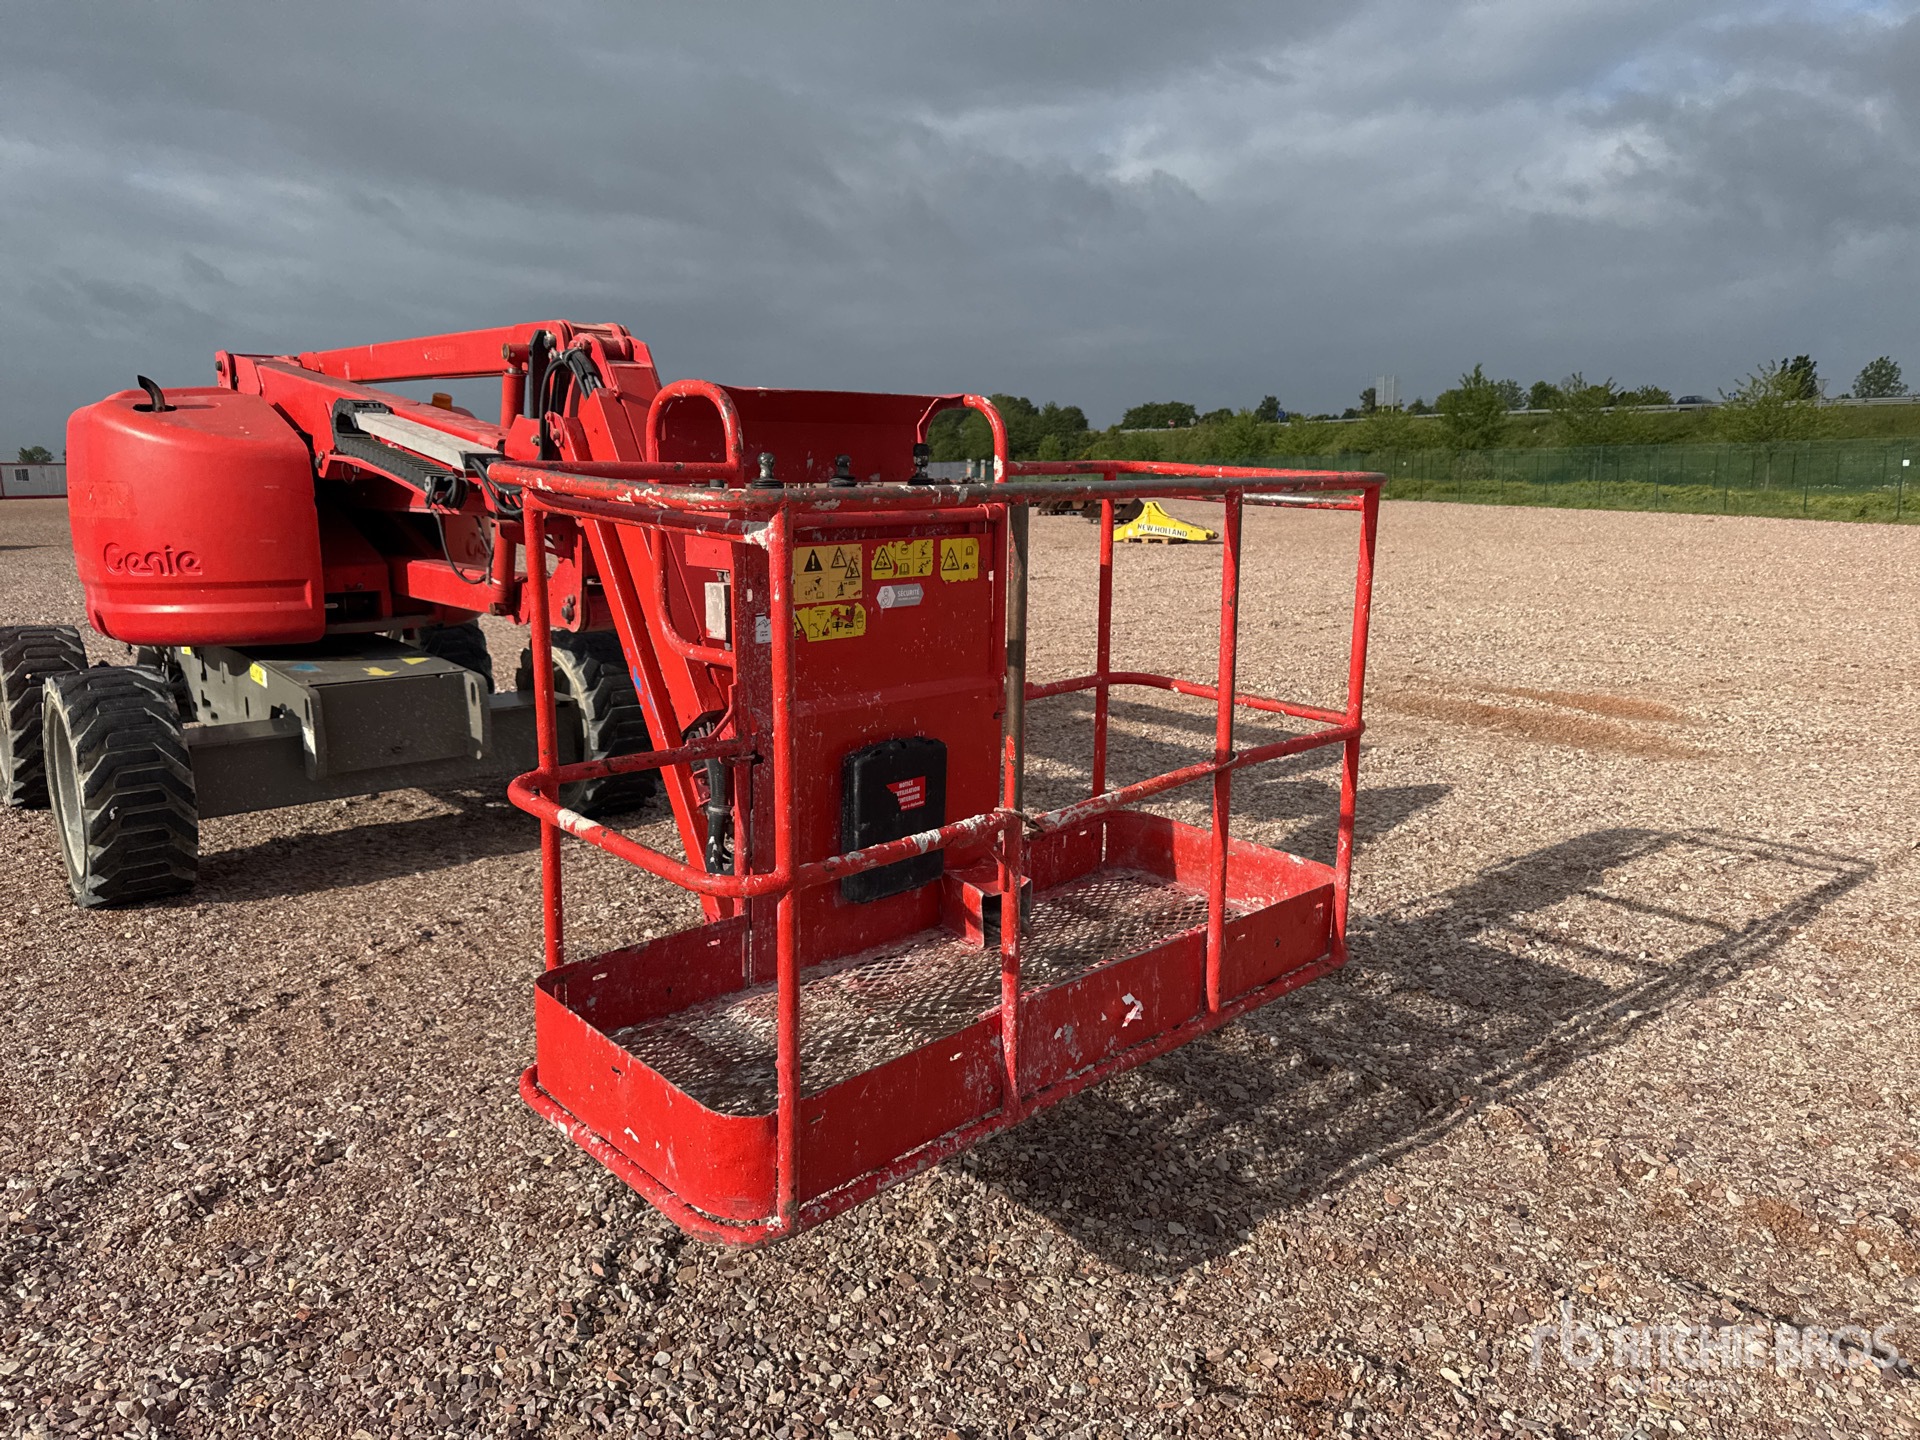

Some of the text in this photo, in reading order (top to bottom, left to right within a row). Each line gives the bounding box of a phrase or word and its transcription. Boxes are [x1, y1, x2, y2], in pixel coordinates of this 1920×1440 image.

[1137, 523, 1188, 538] NEW HOLLAND
[103, 542, 203, 577] Genie
